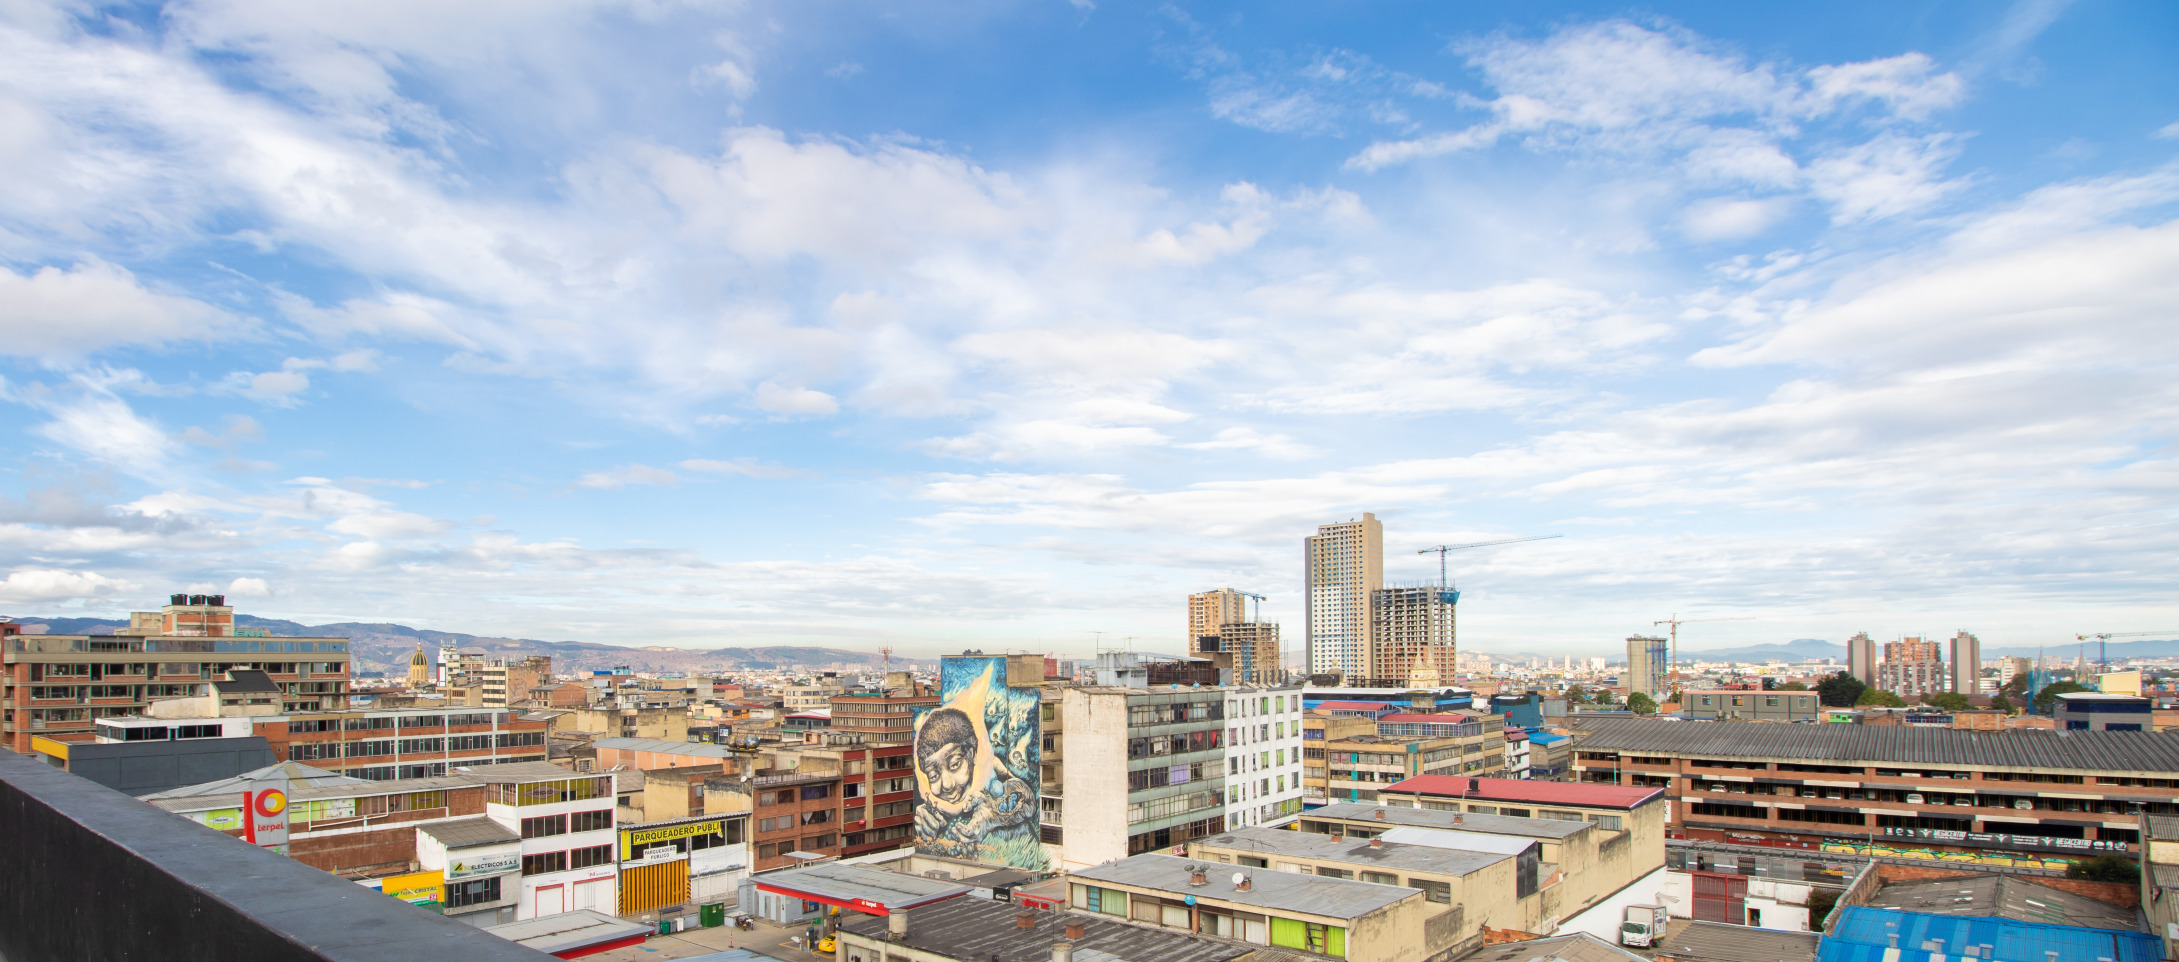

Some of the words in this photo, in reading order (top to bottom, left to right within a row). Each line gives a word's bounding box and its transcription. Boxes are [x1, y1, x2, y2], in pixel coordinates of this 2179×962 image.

[257, 822, 284, 832] terpel
[635, 827, 695, 842] PARQUEADERO
[697, 822, 720, 832] PUBLI
[2056, 838, 2092, 846] MEGACENTRO
[645, 847, 675, 855] PARQUEADERO
